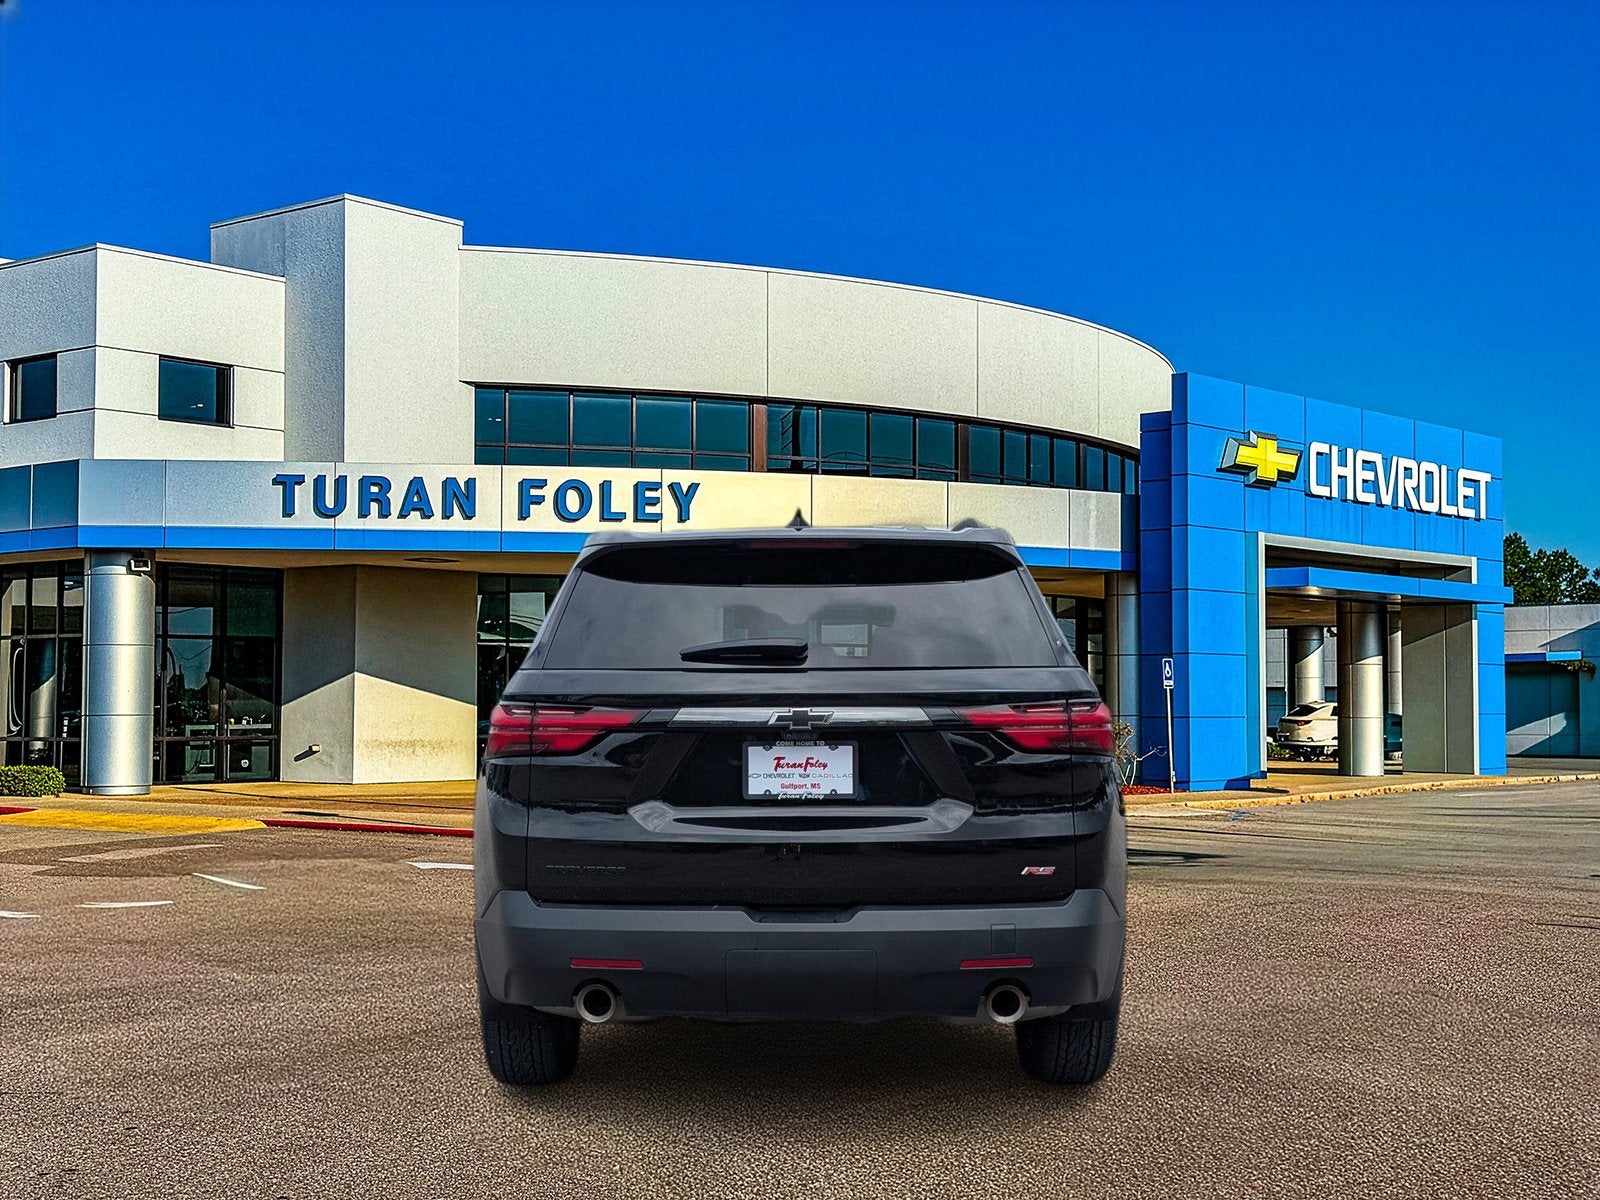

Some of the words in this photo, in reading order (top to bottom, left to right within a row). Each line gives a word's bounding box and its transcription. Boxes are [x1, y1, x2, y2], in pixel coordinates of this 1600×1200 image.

[272, 473, 476, 520] TURAN
[517, 478, 701, 524] FOLEY
[1306, 440, 1492, 520] CHEVROLET
[1021, 866, 1056, 875] RS
